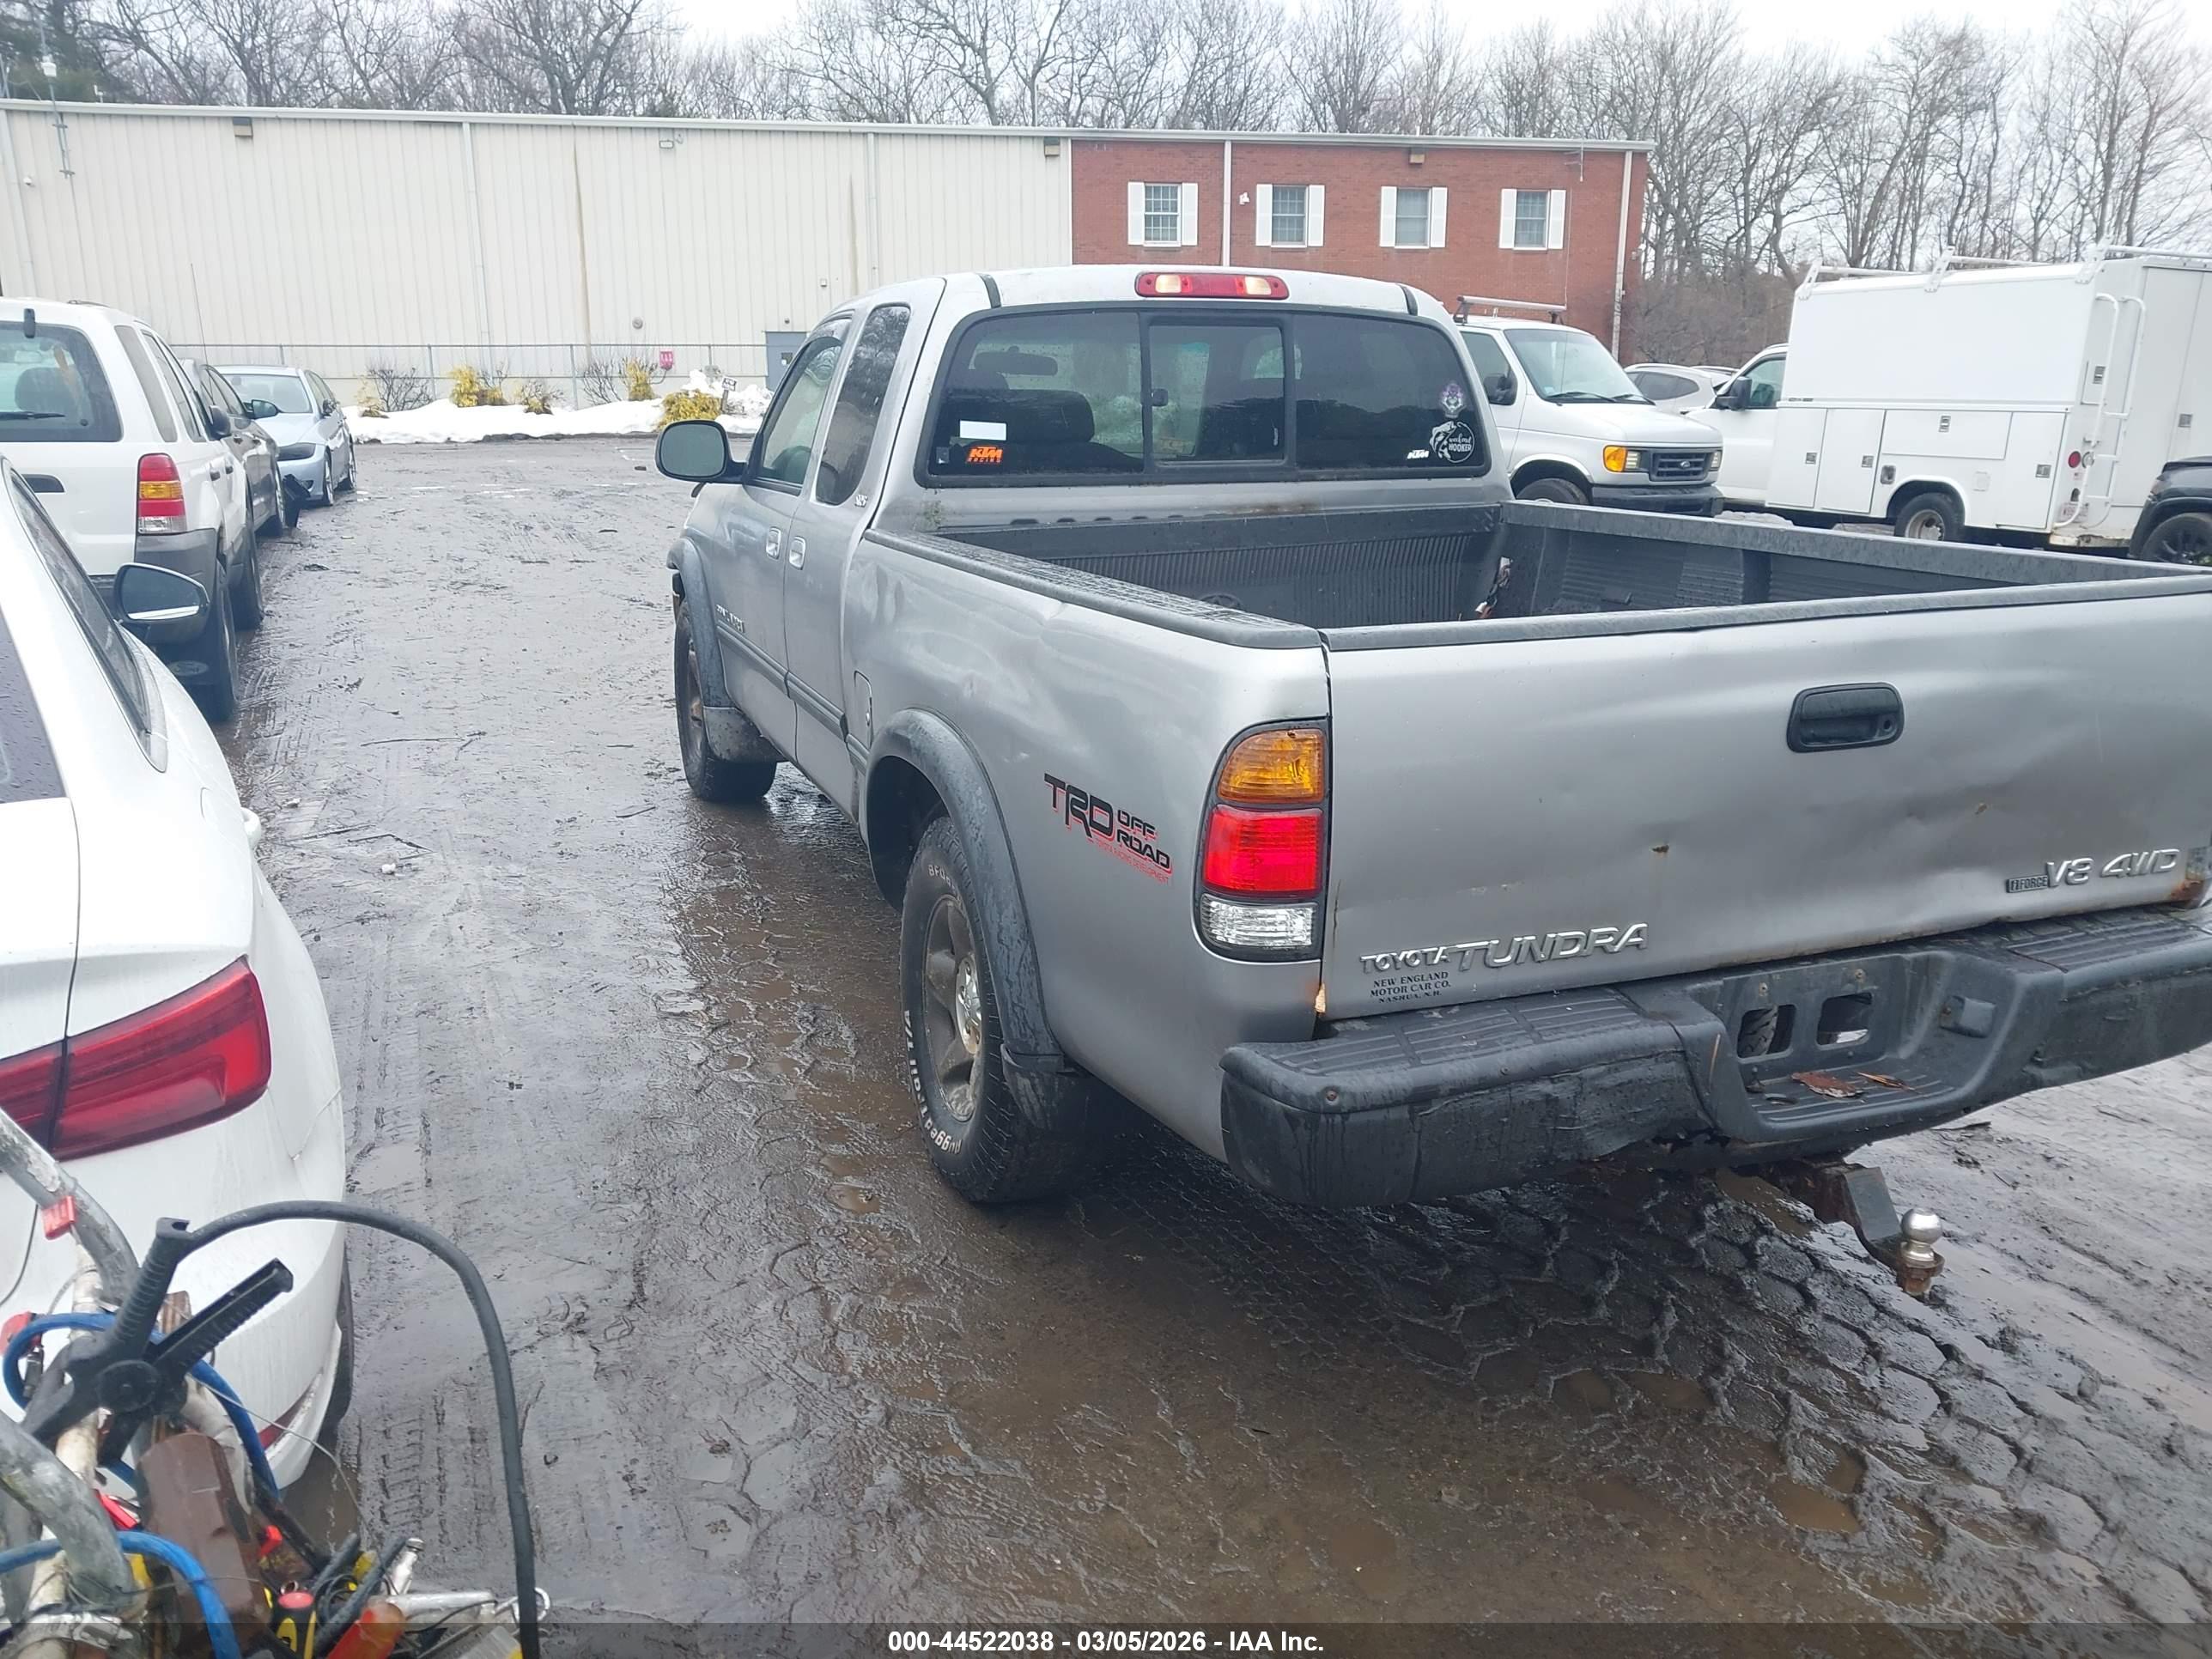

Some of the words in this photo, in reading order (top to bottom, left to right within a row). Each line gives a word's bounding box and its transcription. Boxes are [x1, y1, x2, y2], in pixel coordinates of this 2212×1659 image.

[968, 446, 1004, 458] KTM
[1407, 449, 1430, 459] KTM
[1449, 444, 1472, 453] HOOKER
[1043, 772, 1115, 840] TRD
[1117, 809, 1157, 839] OFF
[1117, 829, 1172, 871] ROAD
[2045, 857, 2094, 887] V8
[2100, 848, 2180, 878] 4WD
[1359, 945, 1450, 974] TOYOTA
[1449, 921, 1650, 972] TUNDRA
[1370, 985, 1407, 997] MOTOR
[1410, 982, 1432, 992] CAR
[1434, 980, 1451, 989] CO.
[1373, 977, 1395, 988] NEW
[1401, 971, 1449, 984] ENGLAND
